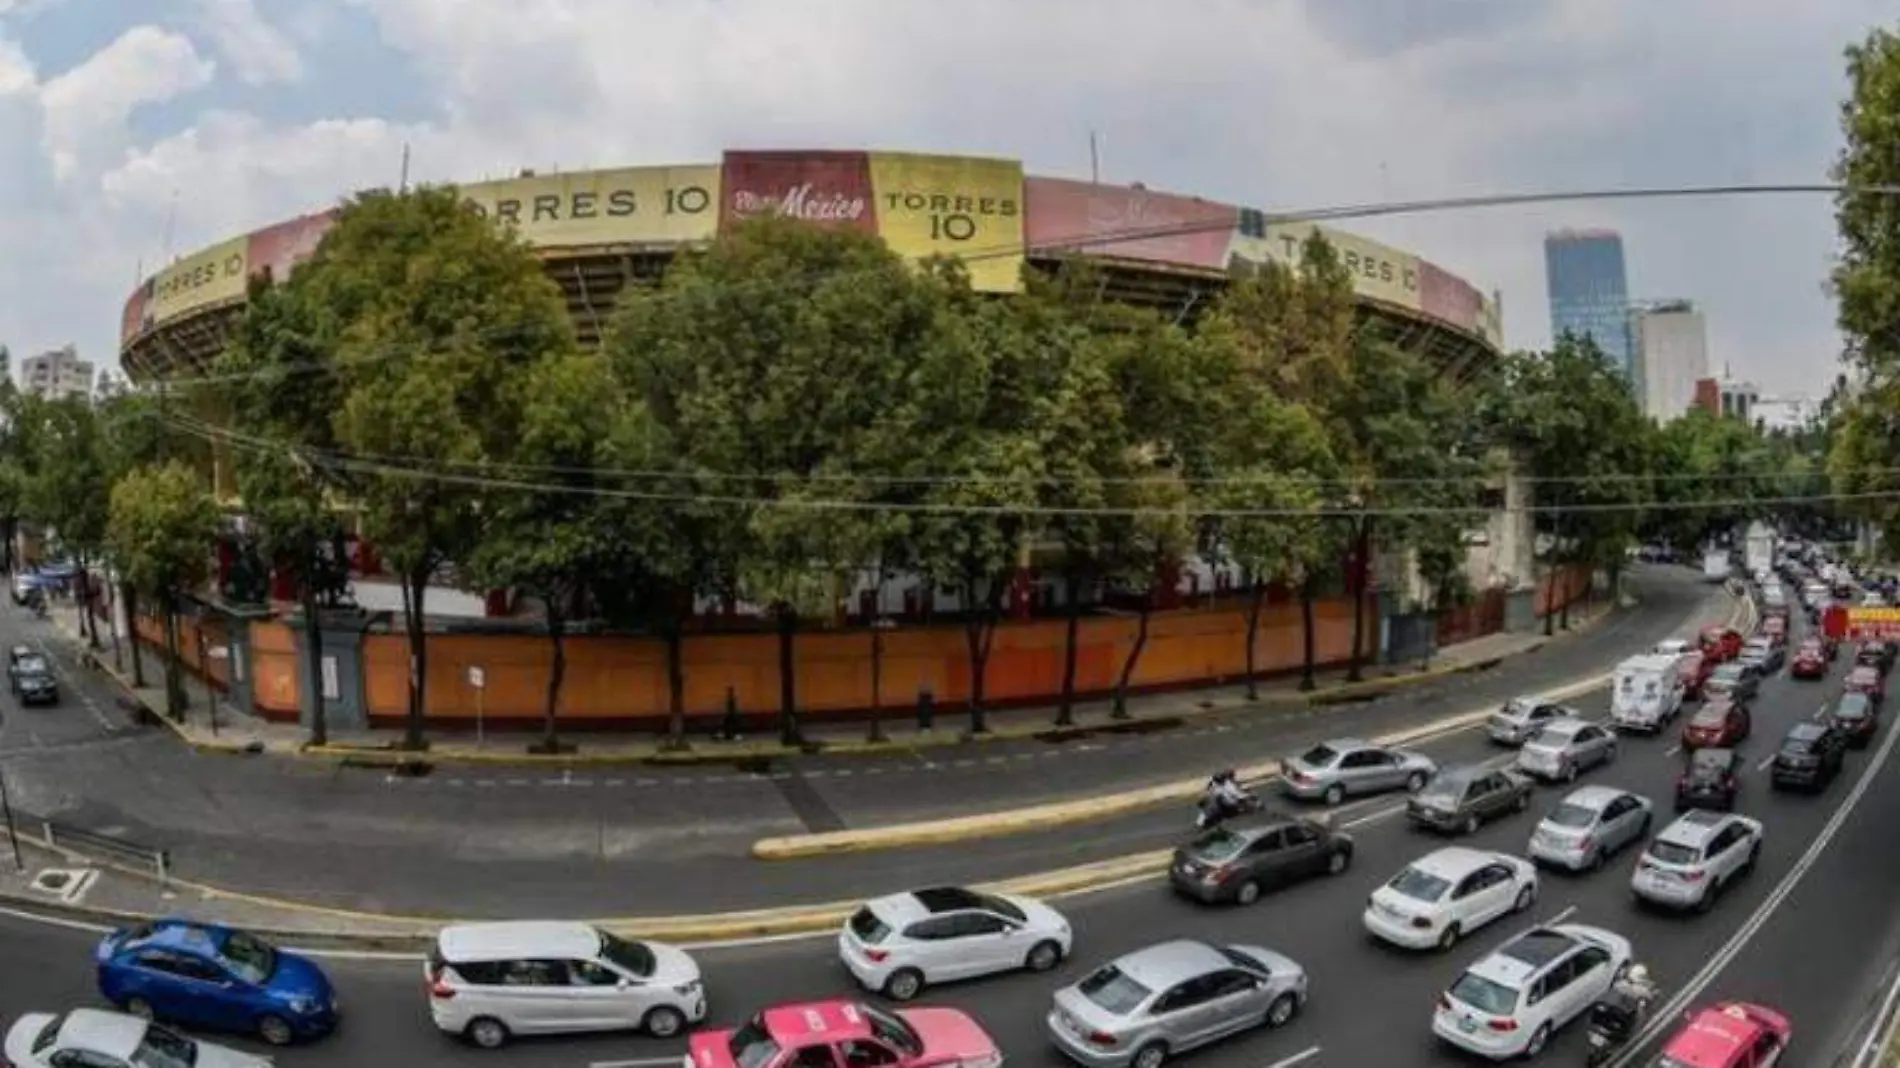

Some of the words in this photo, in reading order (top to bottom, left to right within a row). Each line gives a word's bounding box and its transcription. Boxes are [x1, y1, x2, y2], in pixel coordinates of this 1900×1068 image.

[459, 189, 636, 225] ORRES
[665, 186, 711, 214] 10
[885, 191, 1019, 216] TORRES
[930, 214, 976, 240] 10
[1278, 232, 1394, 284] TRES
